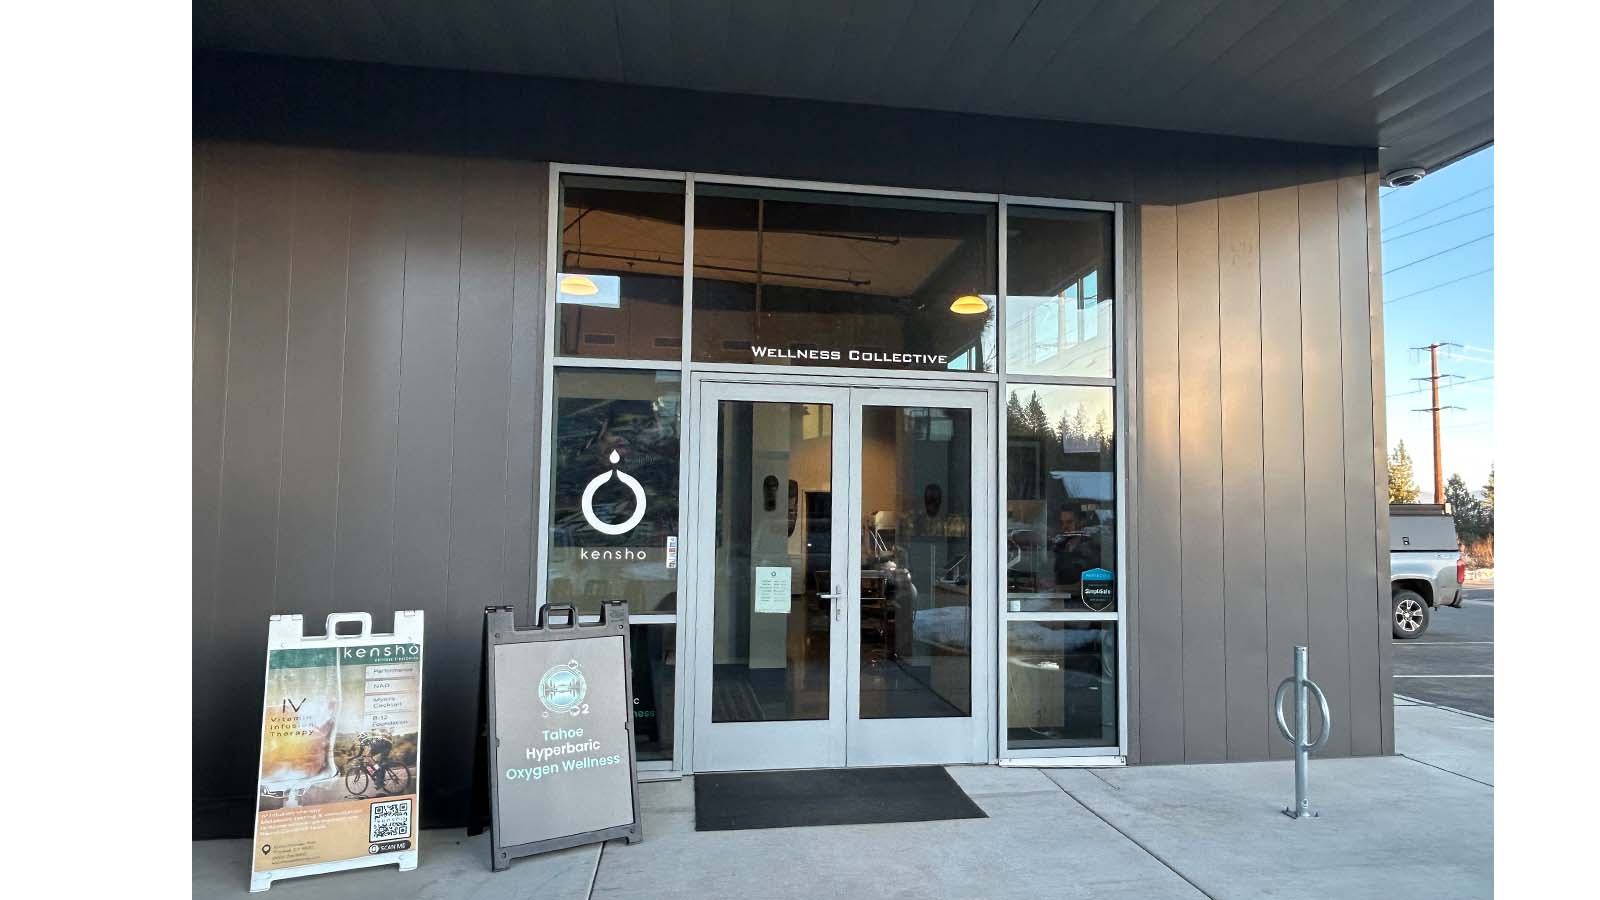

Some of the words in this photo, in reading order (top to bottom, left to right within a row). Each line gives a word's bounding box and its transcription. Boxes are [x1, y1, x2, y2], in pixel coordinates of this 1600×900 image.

[752, 346, 841, 360] WELLNESS
[849, 350, 948, 364] COLLECTIVE
[581, 548, 647, 560] kensho
[343, 644, 419, 659] kensho
[282, 697, 307, 713] IV
[542, 727, 584, 741] Tahoe
[526, 738, 601, 761] Hyperbaric
[506, 763, 559, 781] Oxygen
[562, 754, 621, 771] Wellness
